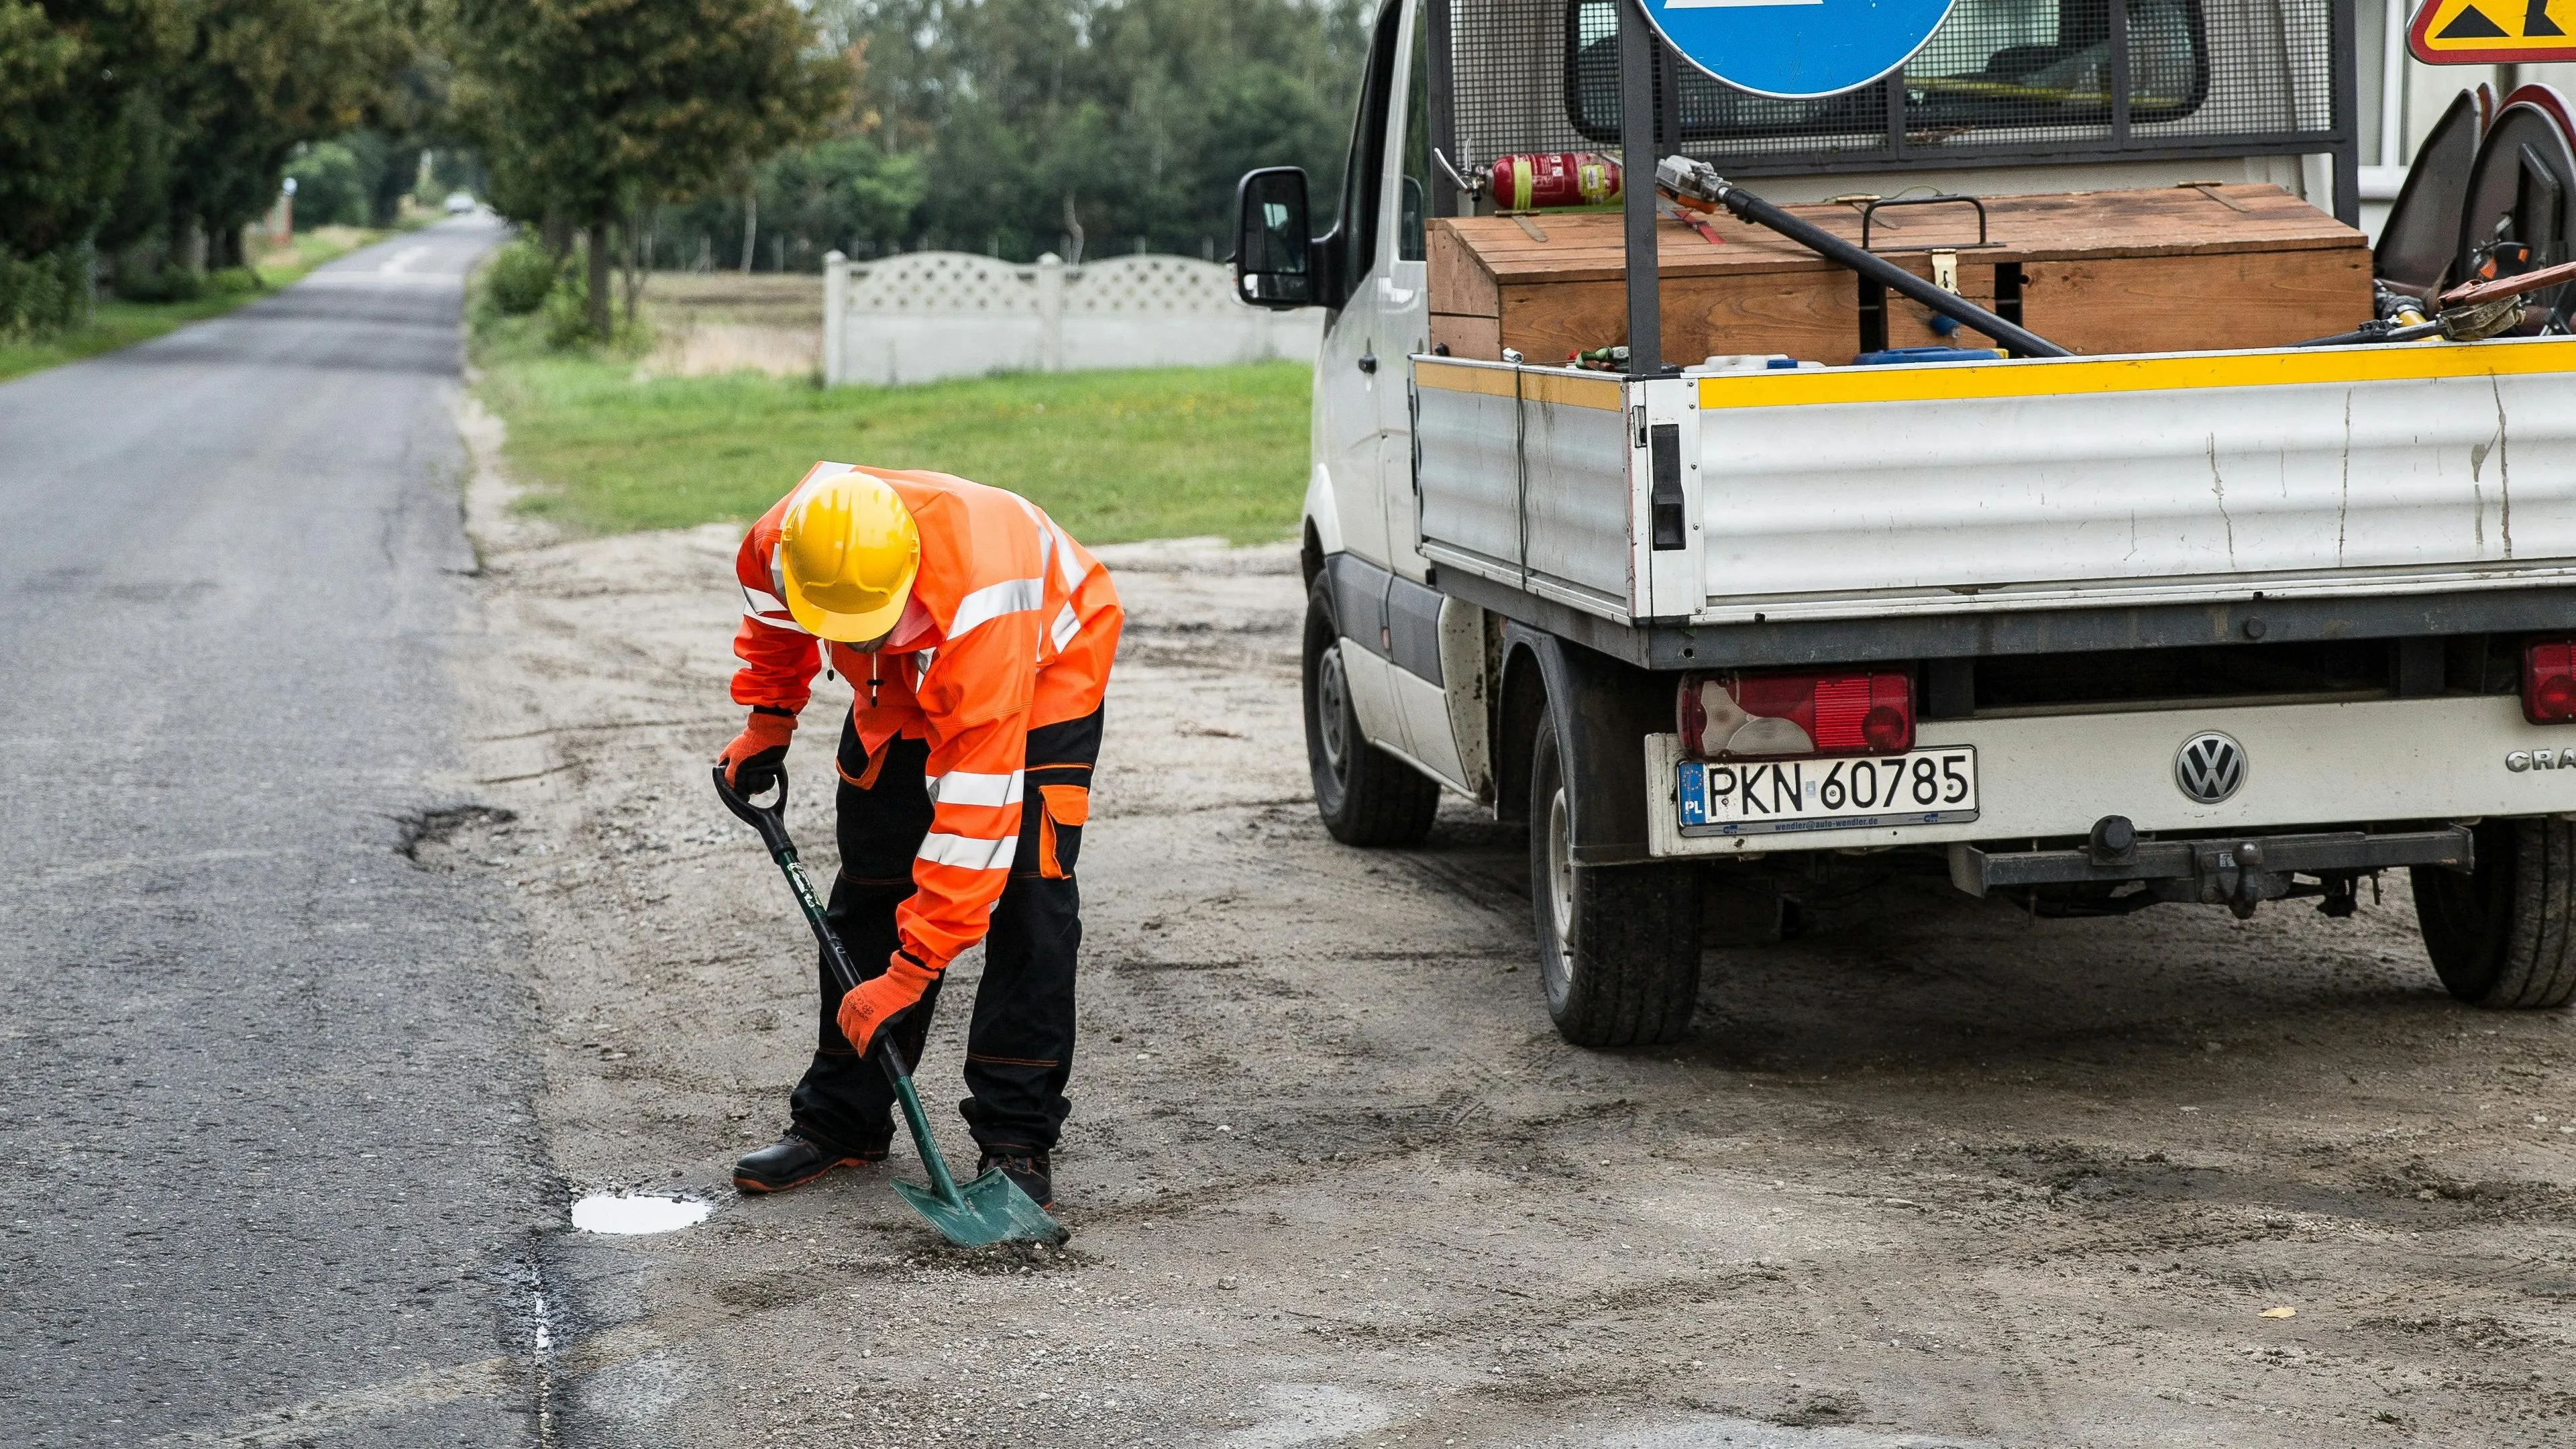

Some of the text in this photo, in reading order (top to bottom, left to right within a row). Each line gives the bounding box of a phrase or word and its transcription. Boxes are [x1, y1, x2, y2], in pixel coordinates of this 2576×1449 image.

[2176, 733, 2245, 804] VW
[2506, 748, 2576, 773] CRA
[1709, 755, 1968, 817] PKN 60785
[1684, 800, 1703, 814] PL
[1775, 816, 1878, 831] wendler@auto-wendler.de
